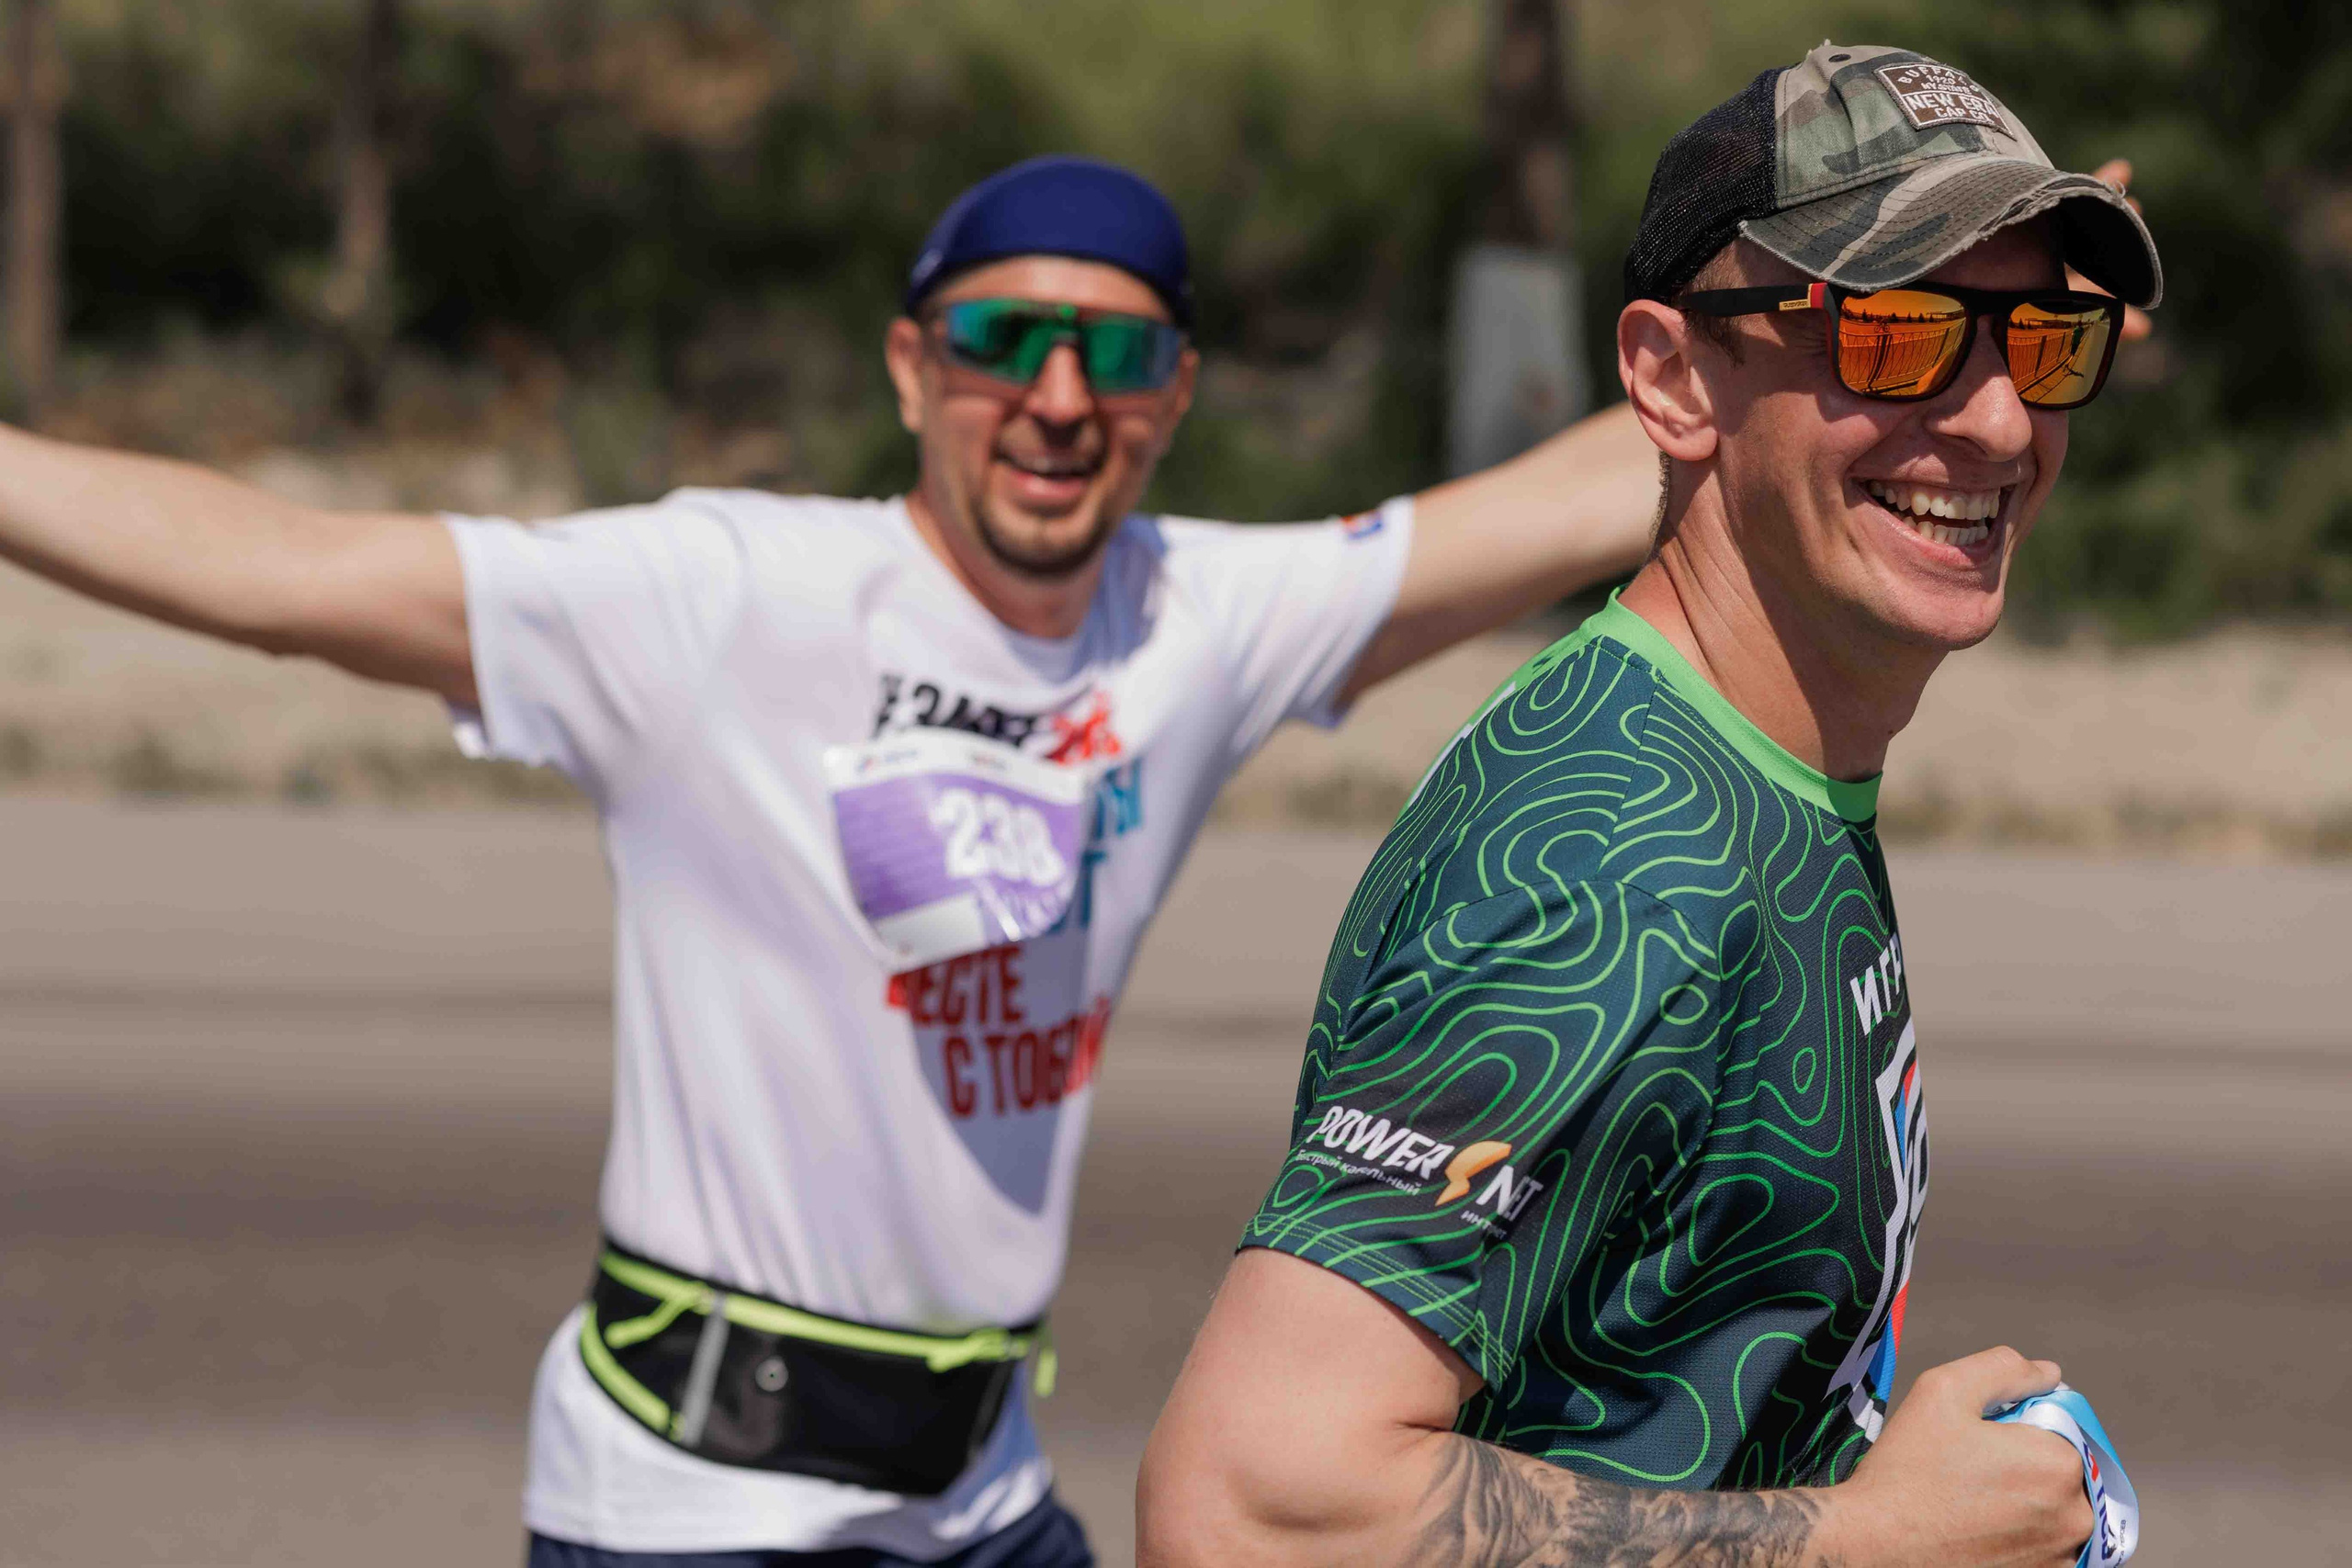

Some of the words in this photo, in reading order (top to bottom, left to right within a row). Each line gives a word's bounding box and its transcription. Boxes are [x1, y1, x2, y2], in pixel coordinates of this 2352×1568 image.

[1897, 66, 1980, 92] BUFFALO
[1926, 74, 1956, 85] 1920
[1905, 93, 1955, 110] NEW
[1959, 95, 1998, 117] ERA
[1934, 107, 1966, 118] CAP
[1306, 1105, 1455, 1180] POWER
